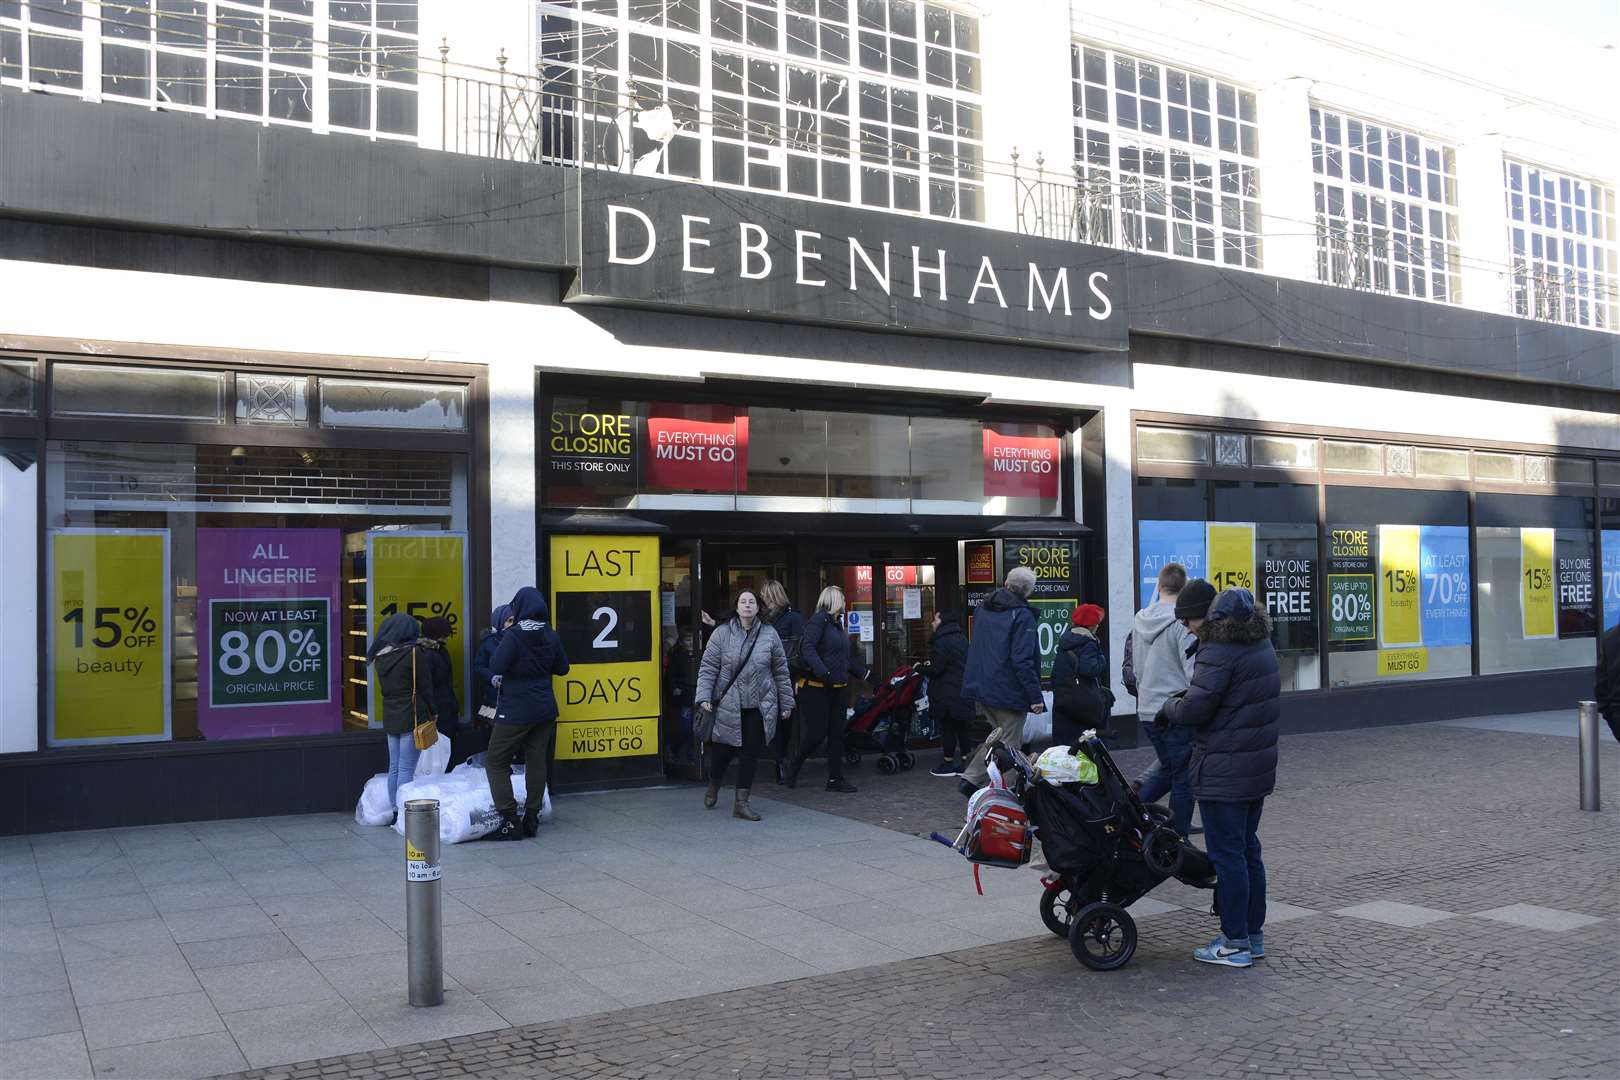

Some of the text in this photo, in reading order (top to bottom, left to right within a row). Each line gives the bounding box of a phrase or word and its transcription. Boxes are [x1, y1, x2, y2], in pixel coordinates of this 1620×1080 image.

[607, 203, 1113, 321] DEBENHAMS
[551, 412, 631, 437] STORE
[551, 436, 631, 454] CLOSING
[657, 430, 735, 446] EVERYTHING
[656, 444, 735, 463] MUST GO
[993, 447, 1051, 460] EVERYTHING
[551, 461, 631, 473] THIS STORE ONLY
[993, 459, 1051, 474] MUST GO
[1332, 529, 1369, 545] STORE
[252, 543, 289, 559] ALL
[1019, 546, 1070, 565] STORE
[1332, 545, 1369, 557] CLOSING
[565, 549, 641, 577] LAST
[1143, 555, 1160, 569] AT
[1265, 559, 1311, 573] BUY ONE
[1424, 554, 1467, 569] AT LEAST
[1560, 558, 1574, 570] BUY
[1575, 558, 1592, 569] ONE
[224, 567, 317, 584] LINGERIE
[887, 570, 904, 581] GO
[1034, 565, 1070, 578] OSING
[1525, 568, 1552, 590] 15%
[1560, 571, 1592, 583] GET ONE
[1053, 584, 1070, 592] ONLY
[1265, 575, 1311, 589] GET ONE
[1332, 582, 1368, 591] SAVE UP TO
[1385, 569, 1416, 593] 15%
[1424, 572, 1468, 605] 70%
[1453, 593, 1468, 604] OFF
[1560, 584, 1593, 603] FREE
[1266, 591, 1311, 614] FREE
[1331, 593, 1371, 622] 80%
[224, 609, 318, 623] NOW AT LEAST
[1043, 608, 1069, 619] UP TO
[1358, 611, 1372, 621] OFF
[63, 606, 156, 649] 15%
[592, 606, 619, 649] 2
[124, 635, 156, 648] OFF
[218, 628, 321, 676] 80%
[77, 656, 144, 677] beauty
[288, 659, 321, 673] OFF
[1387, 660, 1420, 672] MUST GO
[225, 680, 315, 695] ORIGINAL PRICE
[566, 676, 642, 706] DAYS
[572, 724, 643, 739] EVERYTHING
[572, 736, 643, 753] MUST GO
